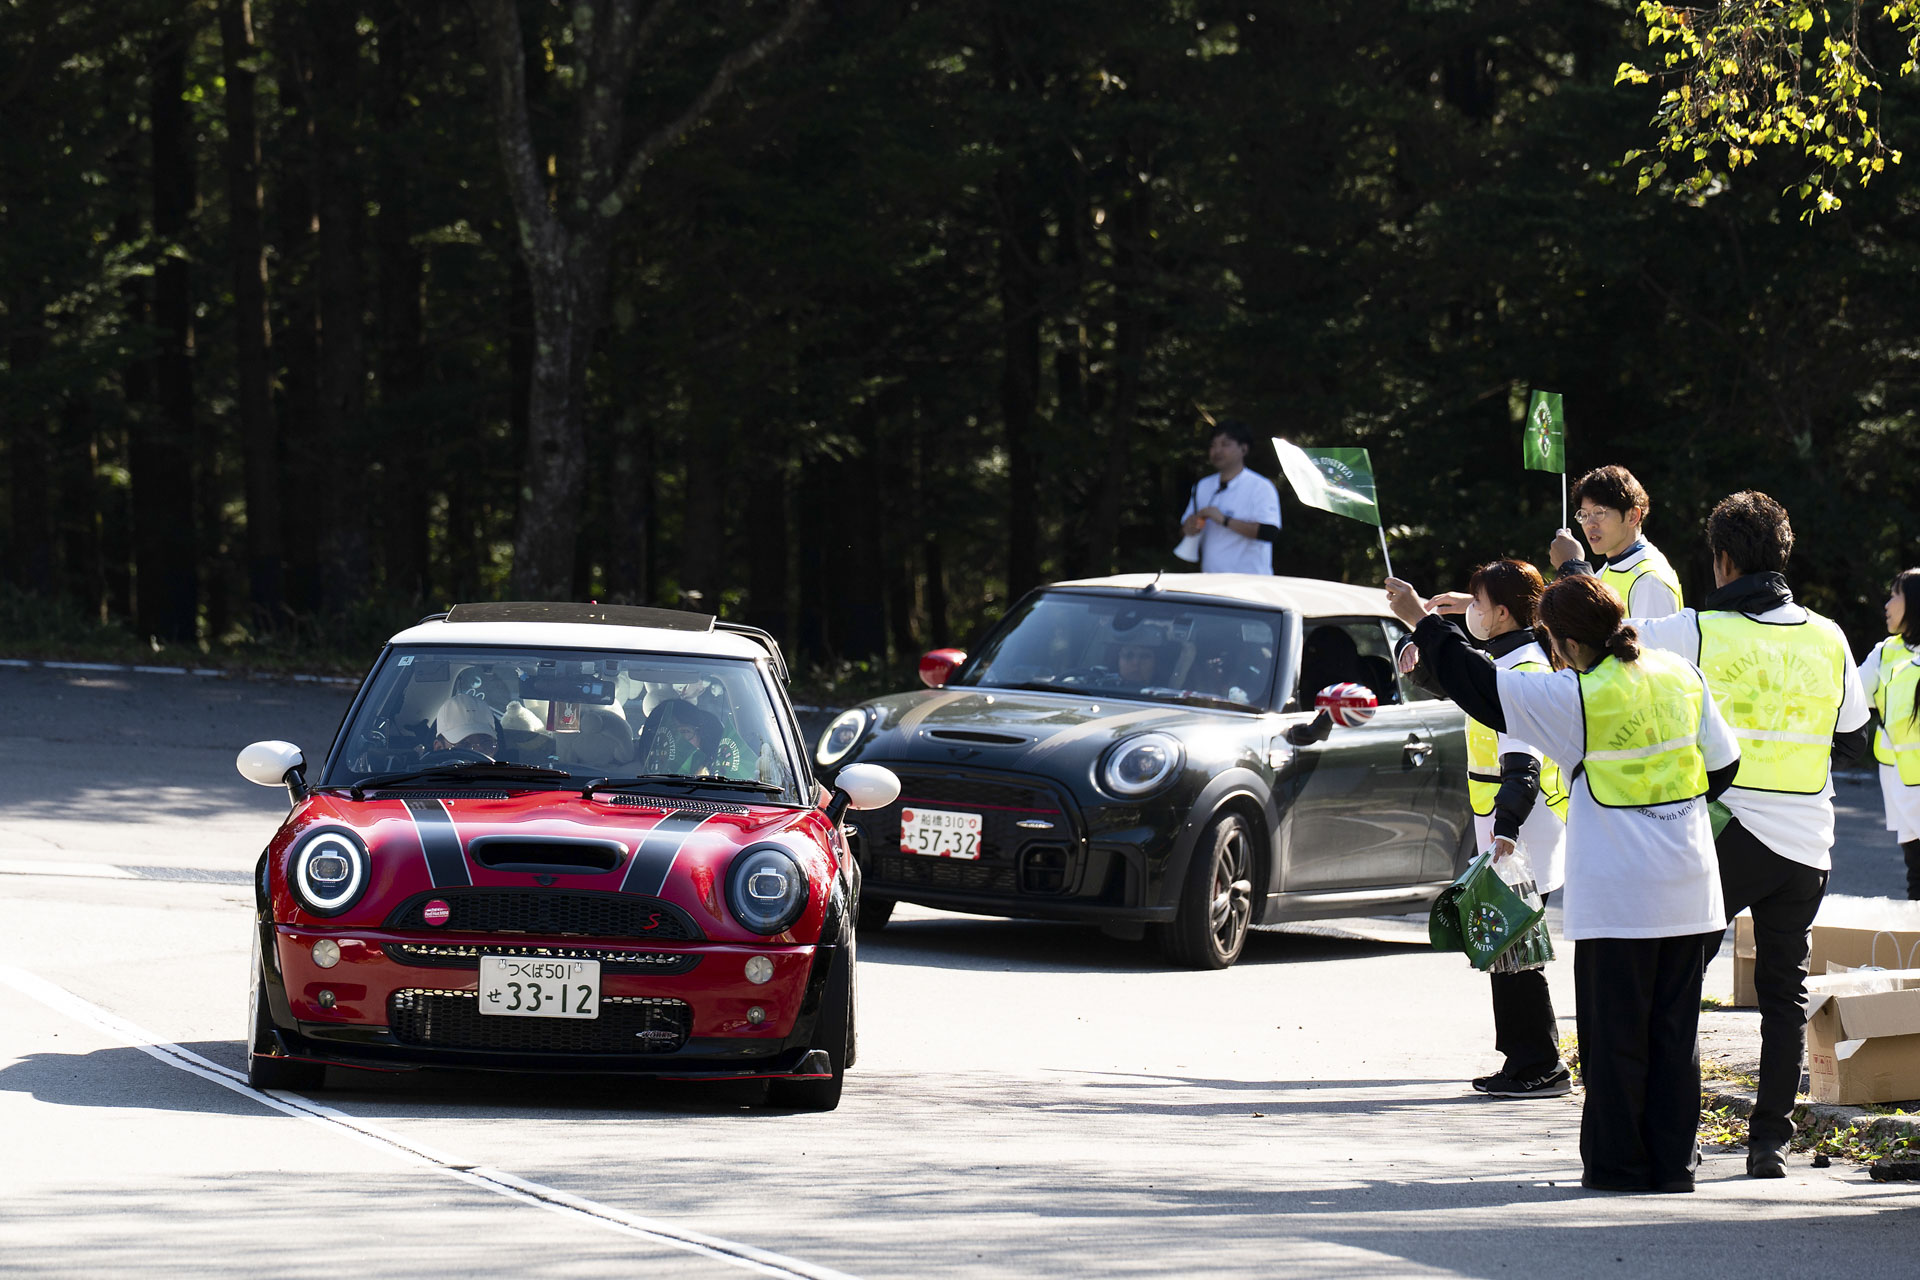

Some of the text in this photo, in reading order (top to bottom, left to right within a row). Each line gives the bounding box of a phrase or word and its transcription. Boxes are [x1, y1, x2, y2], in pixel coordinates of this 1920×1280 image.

[1719, 650, 1761, 687] MINI
[1608, 709, 1647, 751] MINI
[1637, 807, 1657, 819] 2026
[1658, 812, 1678, 821] with
[919, 828, 976, 855] 57-32
[642, 913, 661, 930] S
[1467, 910, 1494, 952] MINI UNITED
[487, 982, 592, 1014] せ 33-12
